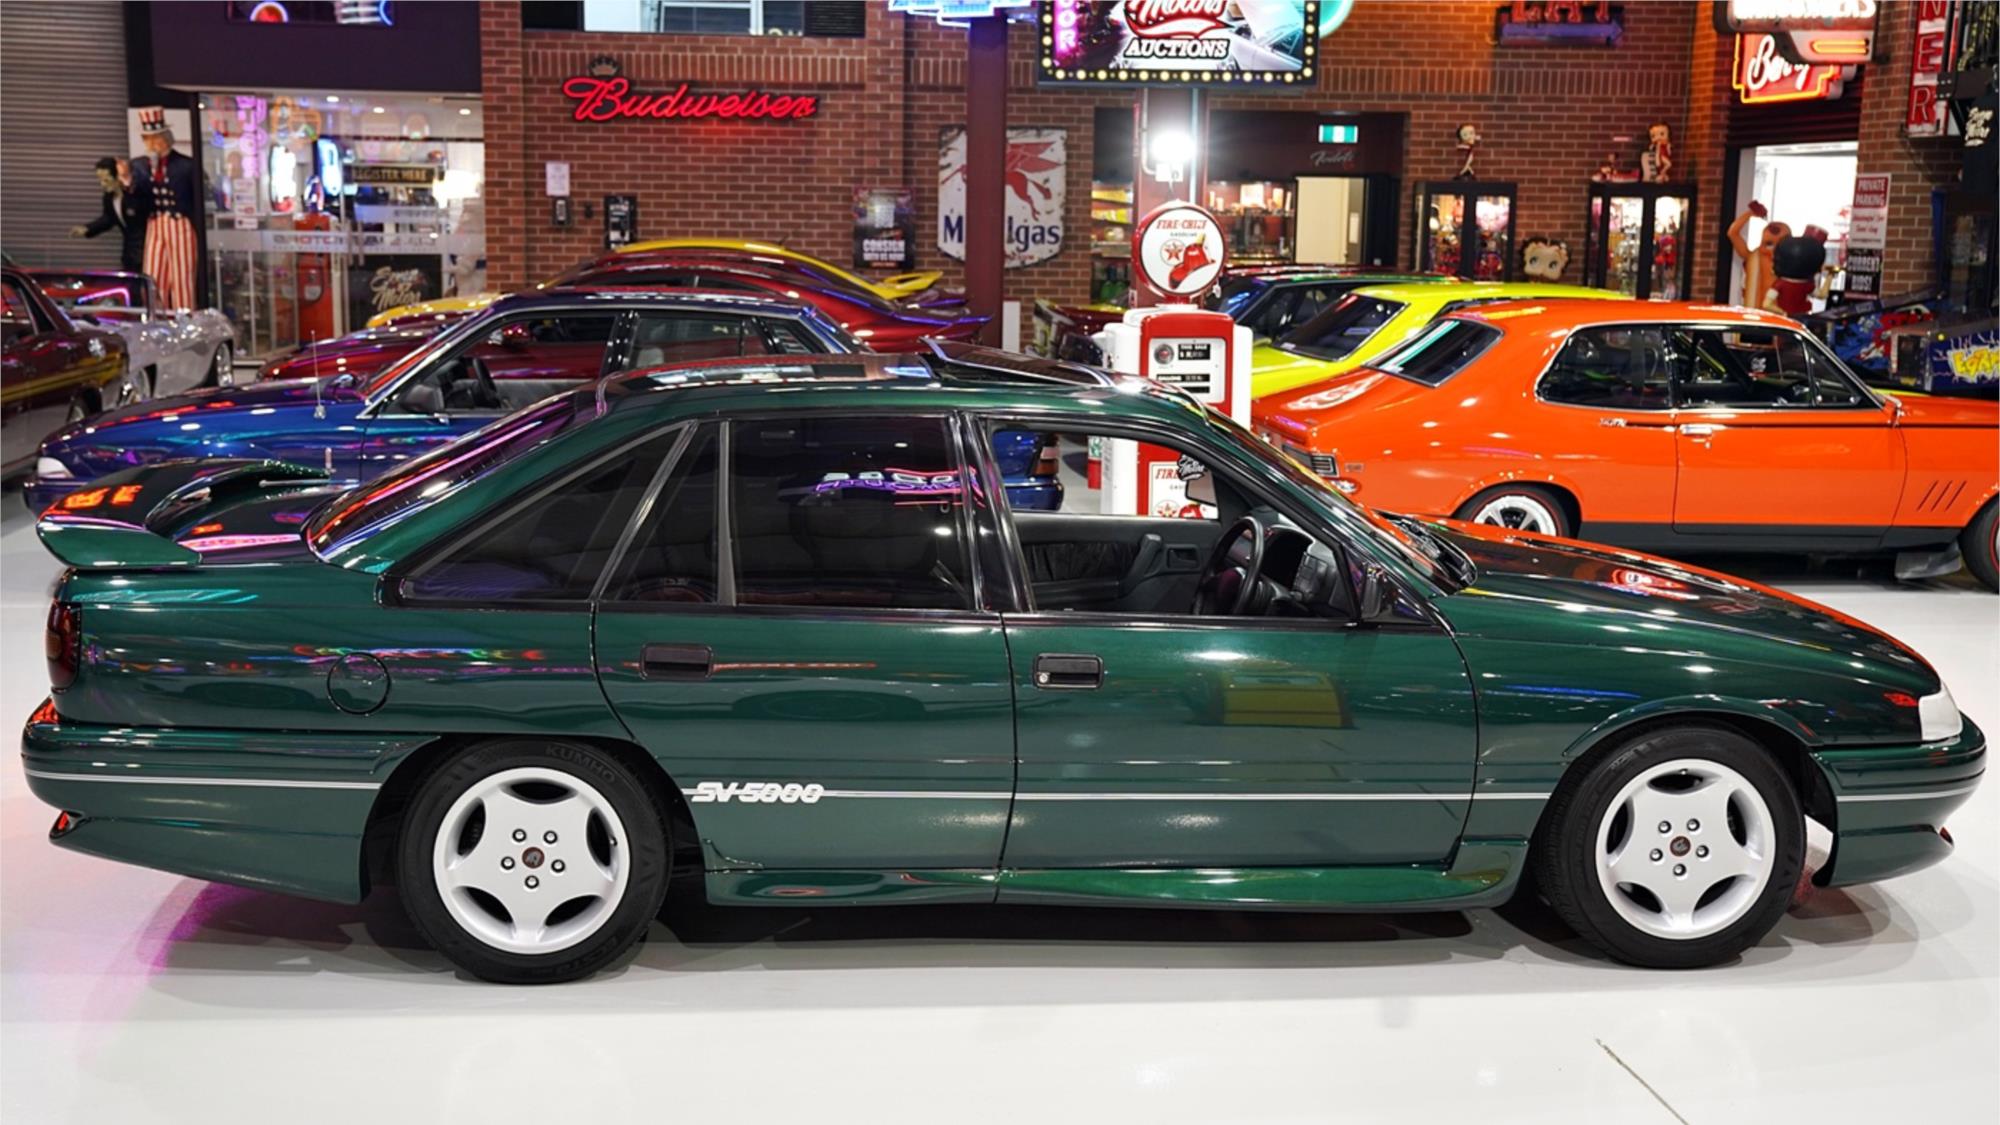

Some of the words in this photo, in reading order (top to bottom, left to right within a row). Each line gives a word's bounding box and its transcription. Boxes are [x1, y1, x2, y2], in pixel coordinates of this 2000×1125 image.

[1124, 39, 1229, 58] AUCTIONS
[562, 77, 818, 121] Budweiser
[1857, 178, 1886, 192] PRIVATE
[1855, 193, 1885, 207] PARKING
[943, 215, 1061, 253] Mlgas
[1847, 255, 1880, 272] CURRENT
[545, 744, 616, 784] KUMHO
